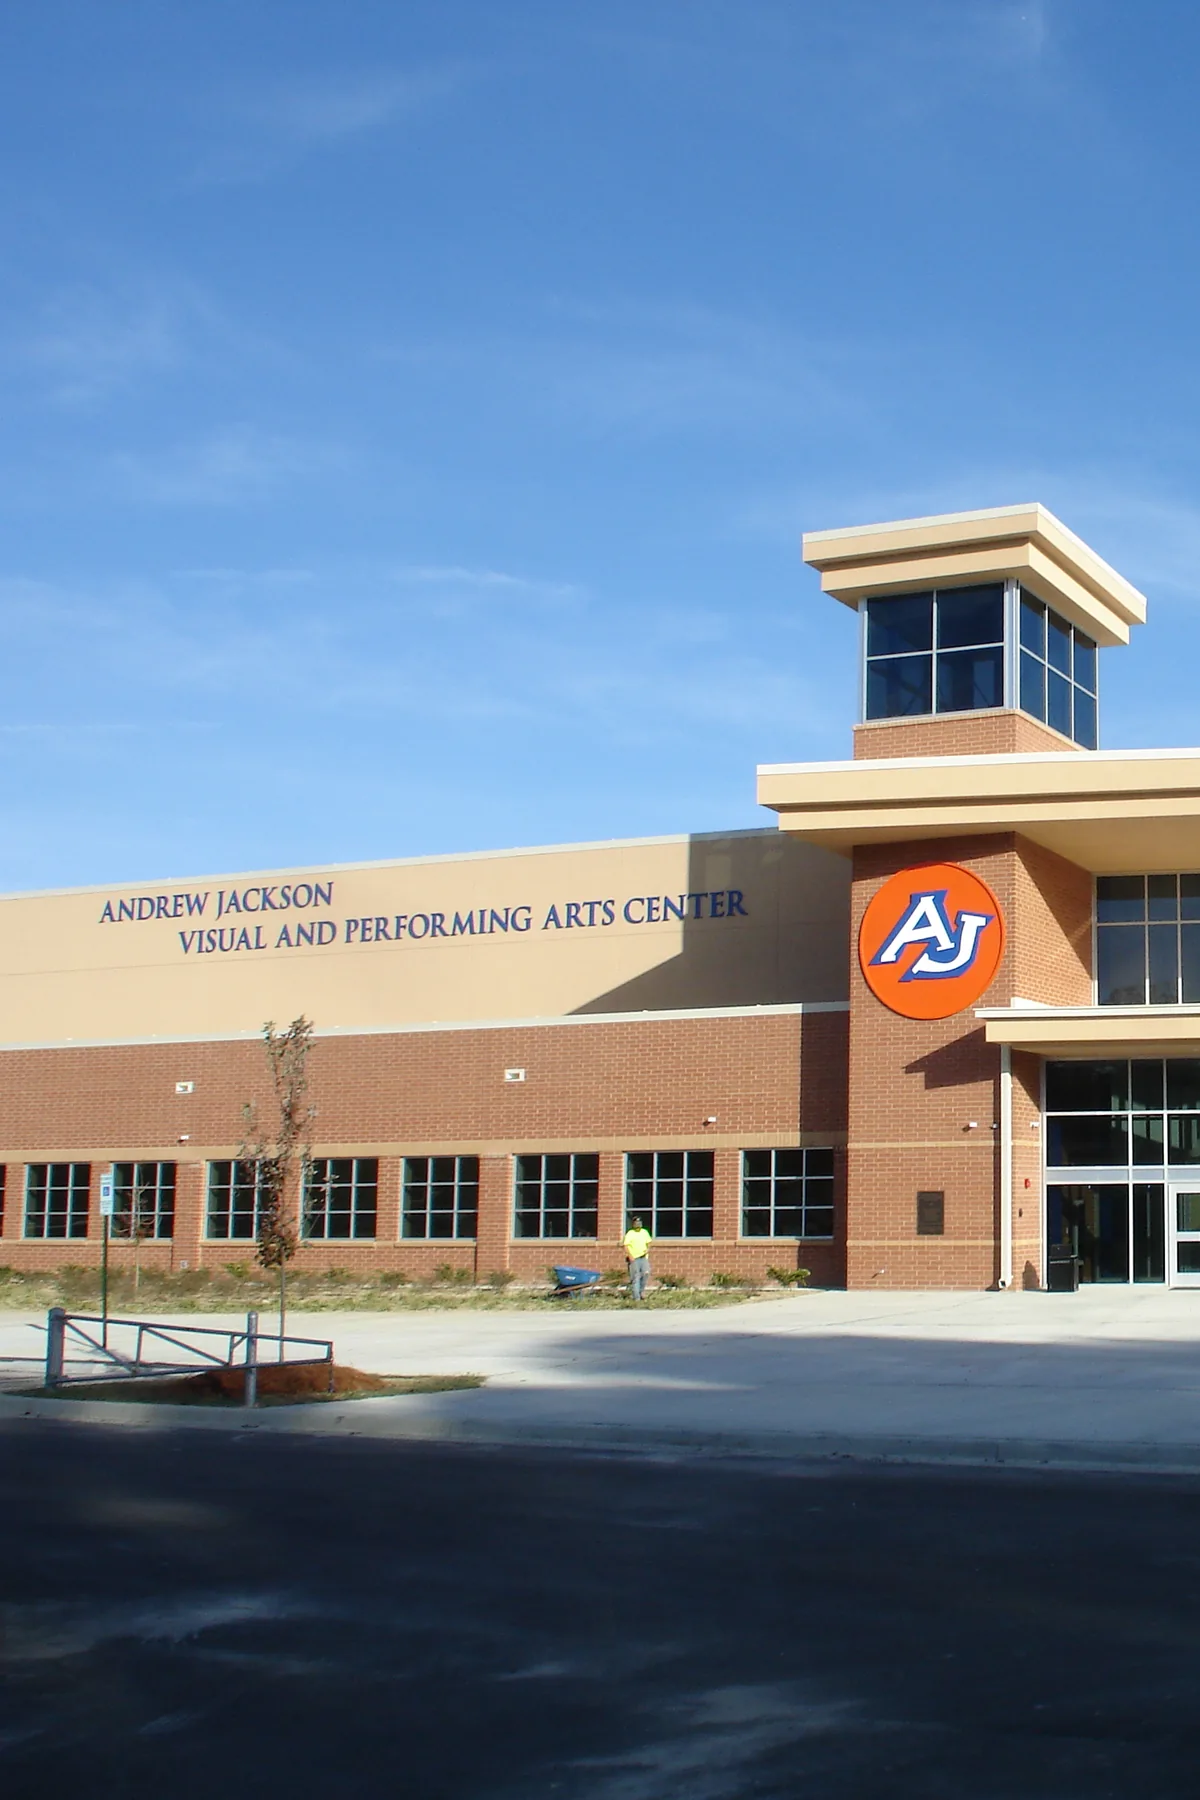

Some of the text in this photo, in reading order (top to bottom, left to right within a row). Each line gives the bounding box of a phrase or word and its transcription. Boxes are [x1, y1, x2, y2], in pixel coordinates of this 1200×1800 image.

[98, 881, 334, 923] ANDREW JACKSON
[178, 889, 749, 954] VISUAL AND PERFORMING ARTS CENTER
[872, 891, 991, 980] AJ
